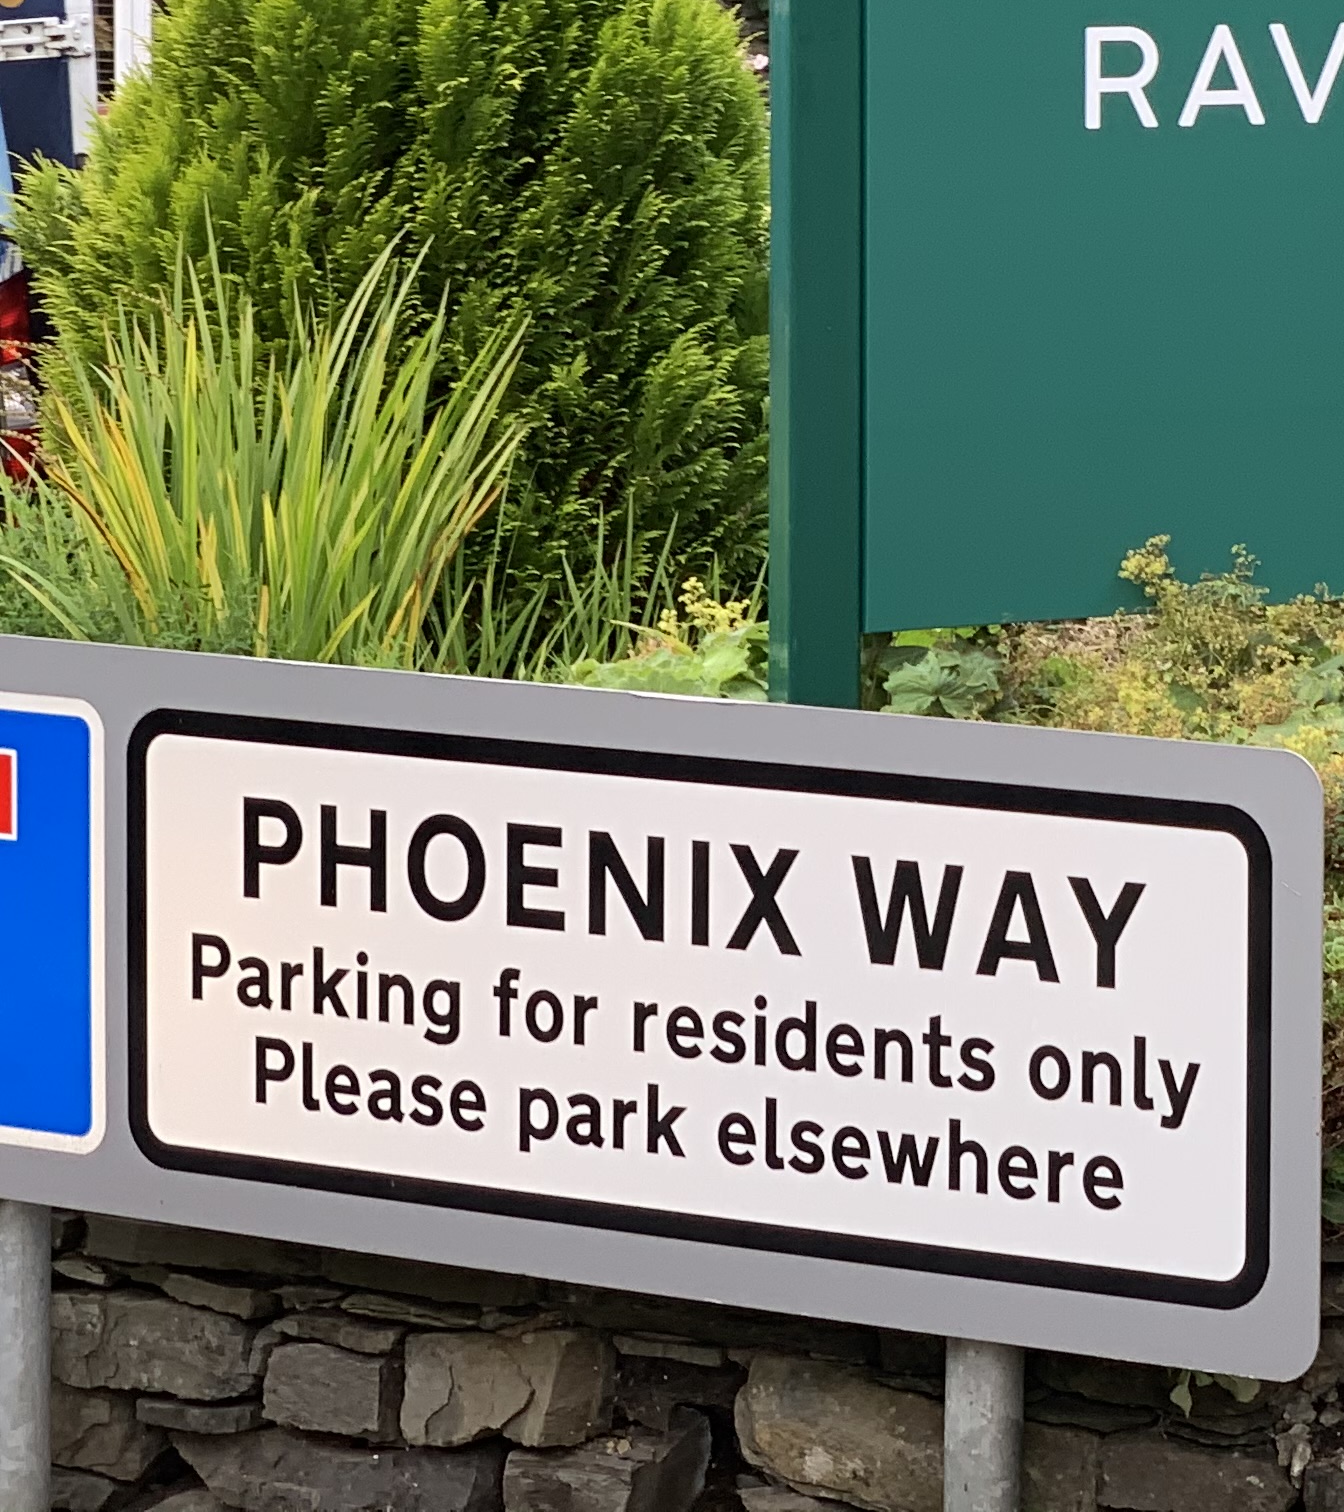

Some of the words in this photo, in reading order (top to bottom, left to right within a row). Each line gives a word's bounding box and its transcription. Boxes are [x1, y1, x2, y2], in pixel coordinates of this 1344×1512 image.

[242, 795, 803, 958] PHOENIX
[850, 854, 1148, 990] WAY
[191, 931, 462, 1047] Parking
[492, 966, 599, 1047] for
[632, 993, 997, 1093] residents
[1027, 1034, 1202, 1131] only
[254, 1035, 488, 1133] Please
[518, 1082, 688, 1159] park
[716, 1095, 1125, 1212] elsewhere
